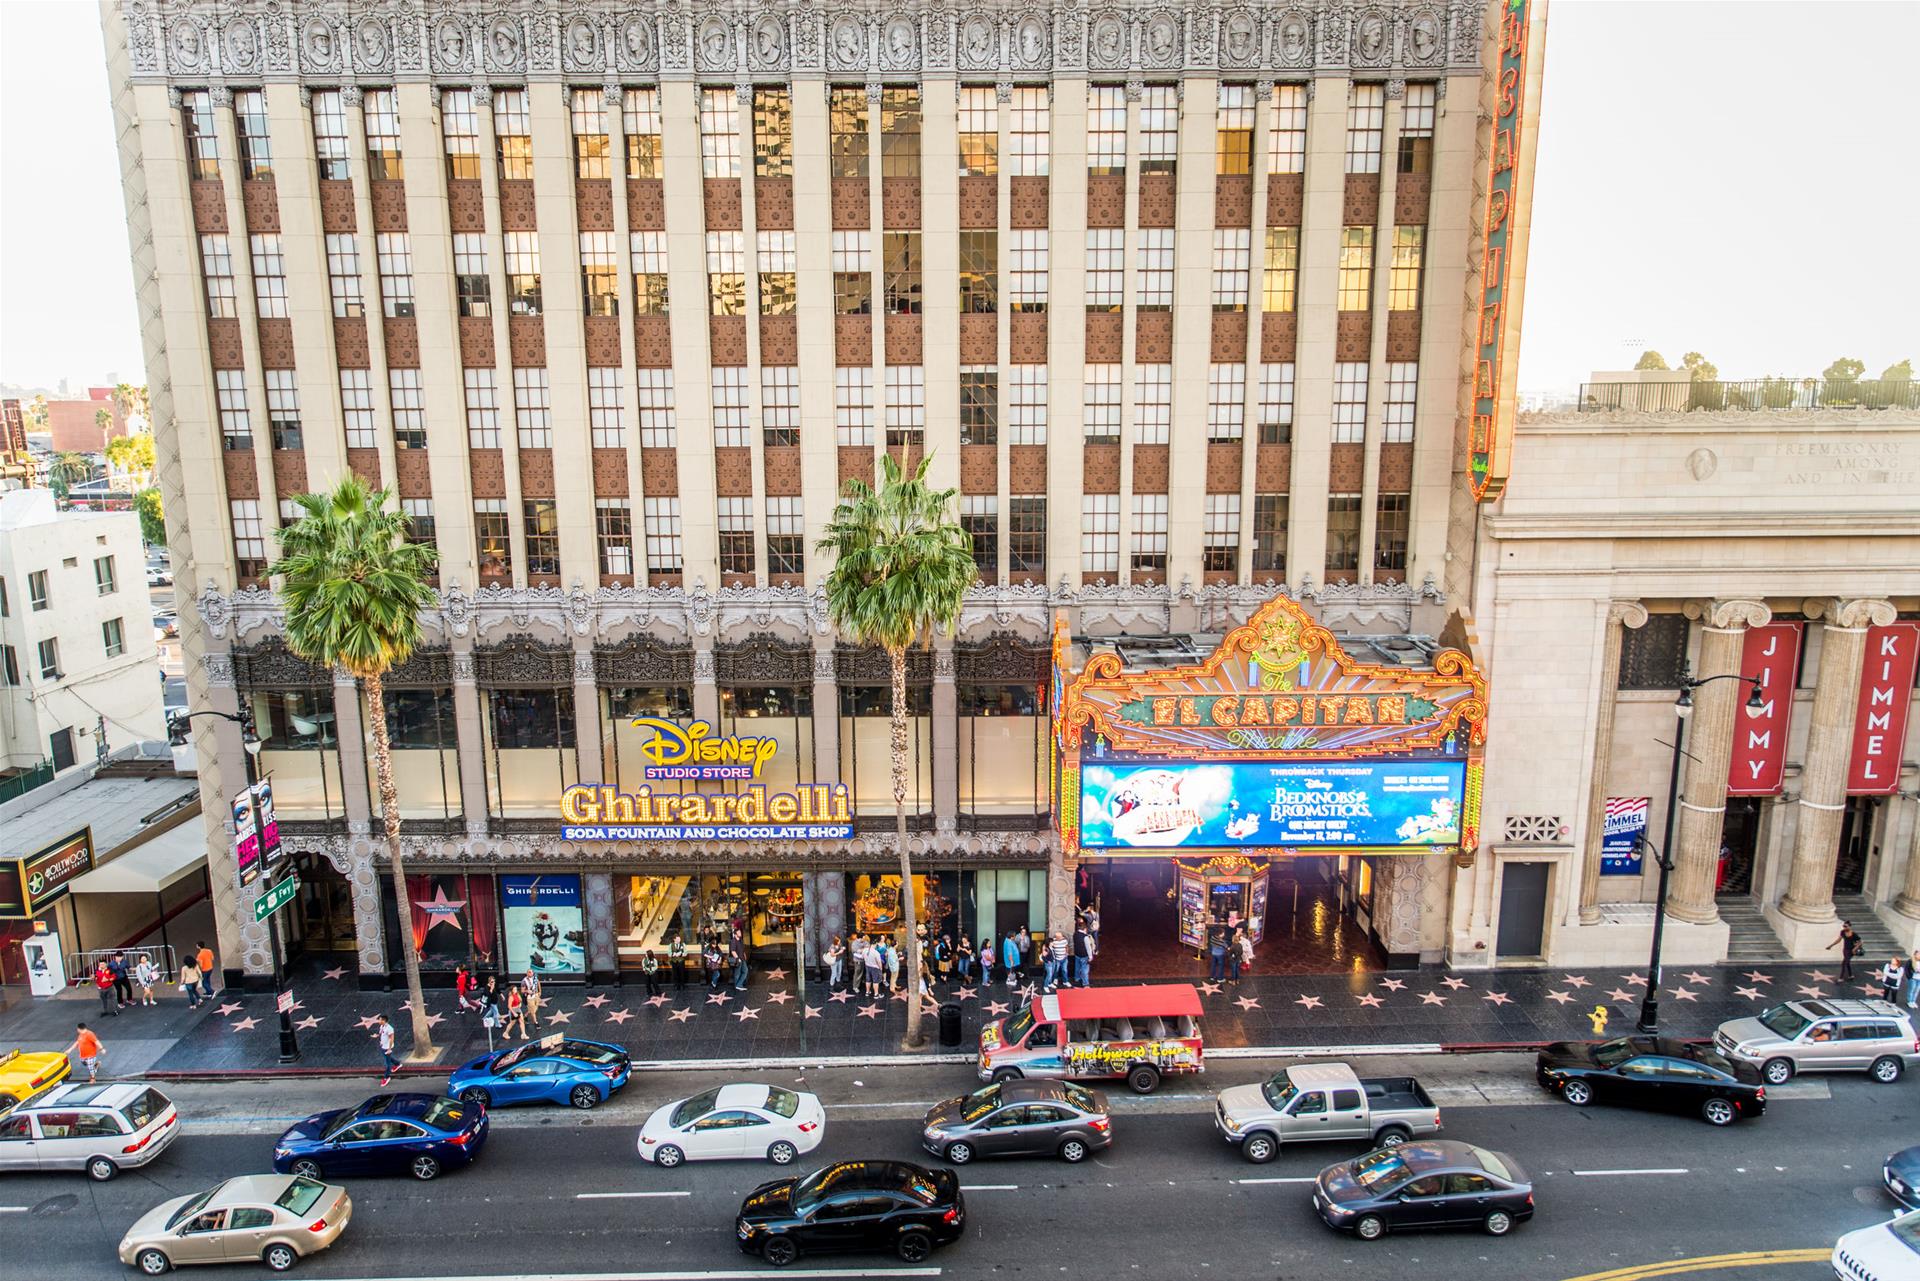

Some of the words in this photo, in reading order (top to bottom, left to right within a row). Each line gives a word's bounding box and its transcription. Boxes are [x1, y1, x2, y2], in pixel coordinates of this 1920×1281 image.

[1776, 442, 1902, 456] FREEMASONRY
[1834, 458, 1899, 469] AMONG
[1784, 472, 1822, 484] AND
[1843, 472, 1861, 484] IN
[1880, 471, 1916, 484] THE
[1261, 672, 1293, 692] The
[1154, 697, 1201, 725] EL
[1211, 696, 1406, 727] CAPITAN
[1863, 635, 1899, 780] KIMMEL
[1227, 730, 1319, 749] Theatre
[646, 767, 700, 778] STUDIO
[702, 767, 751, 778] STORE
[1270, 768, 1325, 776] THROWBACK
[1327, 768, 1373, 776] THURSDAY
[1275, 787, 1356, 804] BEDKNOBS
[560, 785, 852, 823] Ghirardelli
[565, 828, 605, 839] SODA
[608, 828, 683, 839] FOUNTAIN
[684, 828, 716, 839] AND
[718, 828, 807, 838] CHOCOLATE
[810, 827, 850, 838] SHOP
[507, 887, 575, 895] GHIRRDELLI
[1072, 1045, 1146, 1062] Hollywood
[1149, 1043, 1194, 1057] Tours
